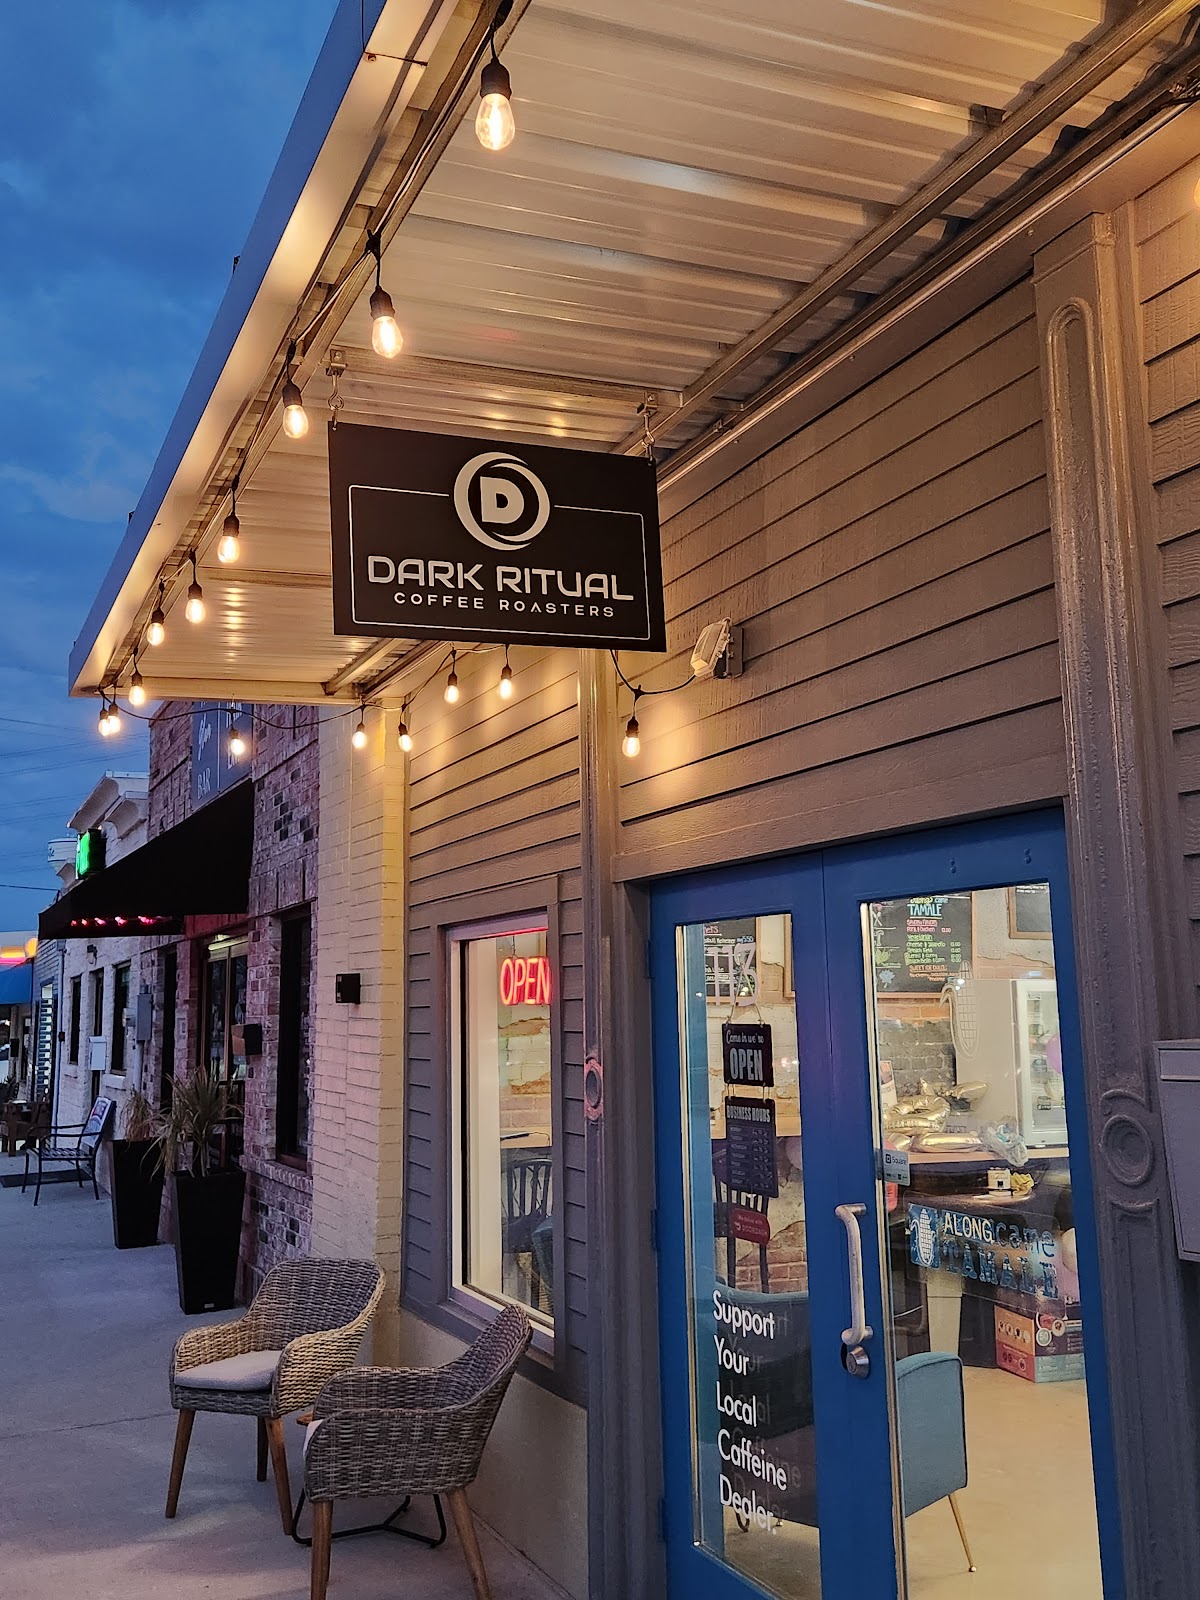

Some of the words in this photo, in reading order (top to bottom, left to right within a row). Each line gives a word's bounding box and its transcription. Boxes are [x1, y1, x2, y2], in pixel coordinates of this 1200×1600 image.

[367, 555, 485, 591] DARK
[496, 565, 634, 601] RITUAL
[394, 592, 485, 610] COFFEE
[499, 599, 614, 618] ROASTERS
[907, 903, 942, 916] TAMALE
[500, 957, 551, 1005] OPEN
[730, 1047, 763, 1081] OPEN
[726, 1105, 752, 1121] BUSINESS
[752, 1107, 771, 1123] HOURS
[944, 1212, 994, 1244] ALONG
[996, 1221, 1055, 1258] came
[942, 1240, 1060, 1300] TAMALE
[713, 1289, 775, 1340] Support
[713, 1334, 749, 1376] Your
[716, 1380, 757, 1428] Local
[717, 1428, 787, 1491] Caffeine
[720, 1473, 777, 1536] Dealer.
